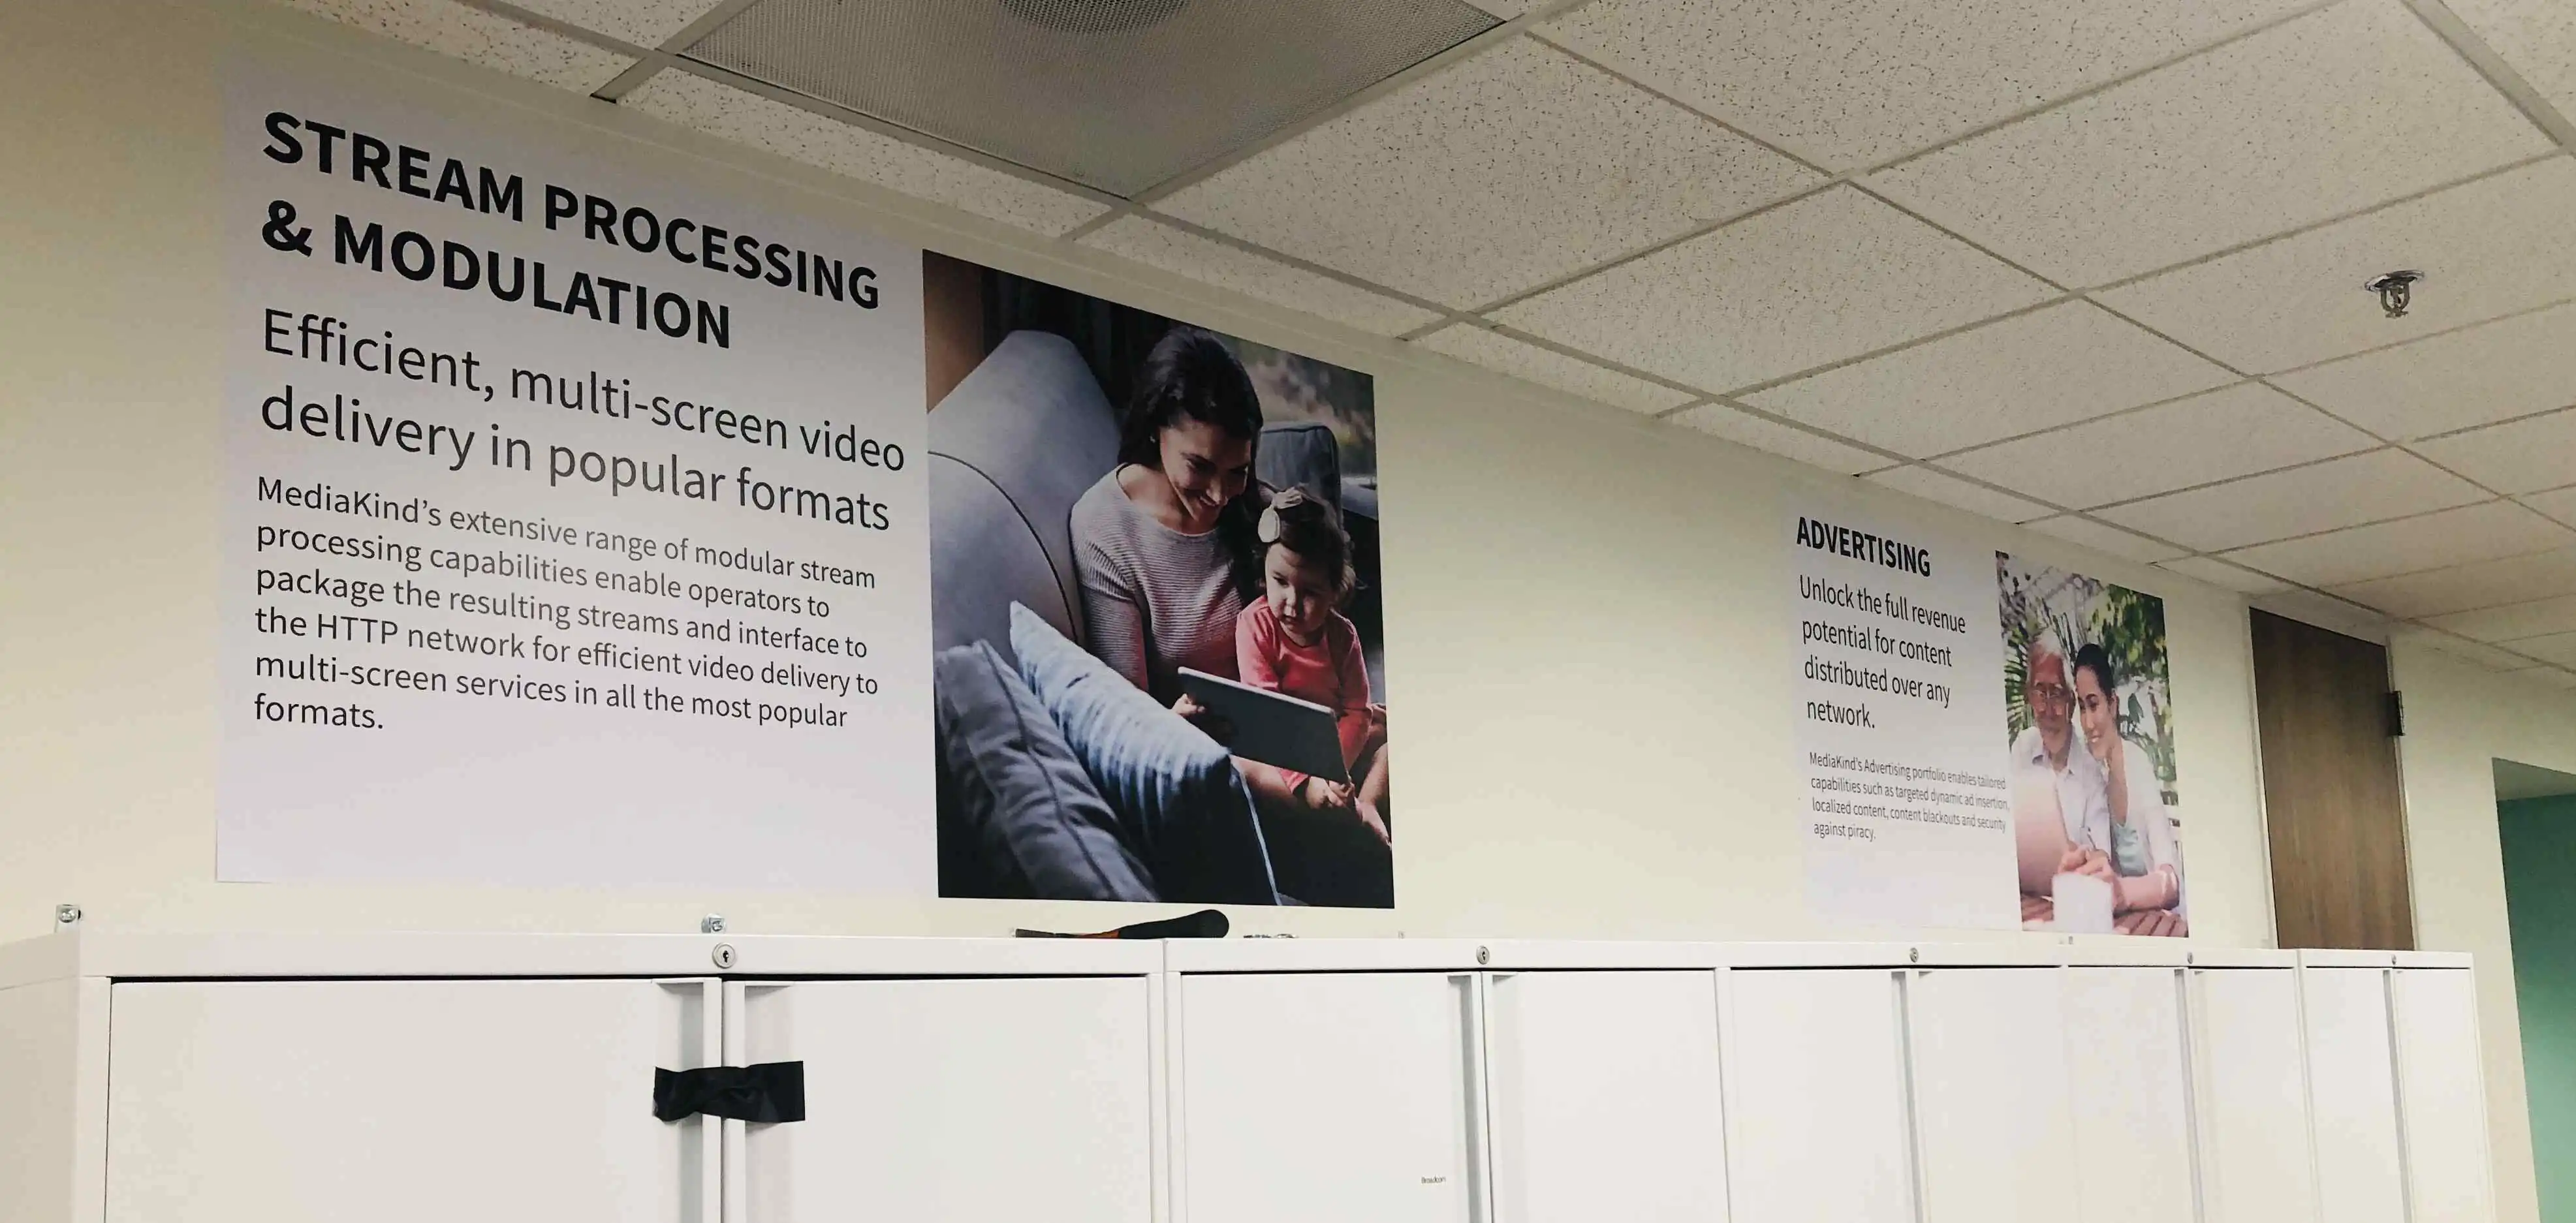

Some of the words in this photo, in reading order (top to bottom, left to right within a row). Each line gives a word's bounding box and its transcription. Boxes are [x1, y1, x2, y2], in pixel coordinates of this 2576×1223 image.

[264, 112, 522, 222] STREAM
[546, 185, 877, 309] PROCESSING
[262, 200, 312, 256] &
[335, 214, 729, 348] MODULATION
[266, 309, 493, 401] Efficient,
[512, 369, 786, 449] multi-screen
[800, 421, 903, 471] video
[262, 385, 475, 471] delivery
[492, 424, 530, 471] in
[550, 446, 725, 501] popular
[737, 467, 888, 530] formats
[259, 527, 421, 571] processing
[431, 550, 587, 585] capabilities
[596, 571, 680, 597] enable
[689, 584, 800, 613] operators
[808, 596, 828, 617] to
[450, 512, 576, 545] extensive
[587, 531, 656, 561] range
[665, 538, 689, 561] of
[697, 548, 794, 576] modular
[801, 561, 874, 588] stream
[1797, 517, 1930, 577] ADVERTISING
[258, 569, 384, 607] package
[394, 580, 439, 608] the
[450, 593, 570, 629] resulting
[578, 606, 678, 635] streams
[687, 619, 729, 642] and
[740, 622, 838, 654] interface
[845, 637, 866, 657] to
[1800, 575, 1854, 608] Unlock
[1857, 588, 1881, 614] the
[1885, 593, 1908, 621] full
[1912, 606, 1965, 633] revenue
[255, 607, 306, 636] the
[319, 614, 398, 643] HTTP
[409, 629, 524, 658] network
[533, 636, 570, 662] for
[578, 642, 682, 674] efficient
[689, 655, 753, 681] video
[762, 662, 849, 696] delivery
[856, 674, 877, 694] to
[1803, 621, 1872, 651] potential
[1875, 628, 1895, 654] for
[1900, 641, 1951, 667] content
[255, 693, 383, 728] formats.
[257, 654, 445, 691] multi-screen
[457, 675, 566, 702] services
[575, 680, 596, 704] in
[607, 684, 635, 708] all
[644, 687, 683, 712] the
[693, 698, 751, 719] most
[760, 703, 847, 728] popular
[1805, 655, 1887, 691] distributed
[1893, 677, 1923, 697] over
[1927, 684, 1950, 708] any
[1808, 700, 1874, 728] network.
[1812, 777, 1861, 793] capabilities
[1863, 782, 1882, 795] such
[1885, 786, 1894, 797] as
[1896, 786, 1928, 803] targeted
[1931, 788, 1963, 805] dynamic
[1965, 794, 1974, 806] ad
[1864, 760, 1911, 781] Advertising
[1913, 765, 1947, 781] portfolio
[1948, 771, 1977, 786] enables
[1977, 776, 2005, 789] tailored
[1813, 797, 1851, 814] localized
[1853, 805, 1889, 819] content,
[1891, 809, 1921, 821] content
[1923, 809, 1960, 825] blackouts
[1962, 814, 1975, 827] and
[1977, 818, 2005, 833] security
[1814, 824, 1846, 839] against
[1848, 825, 1876, 842] piracy.
